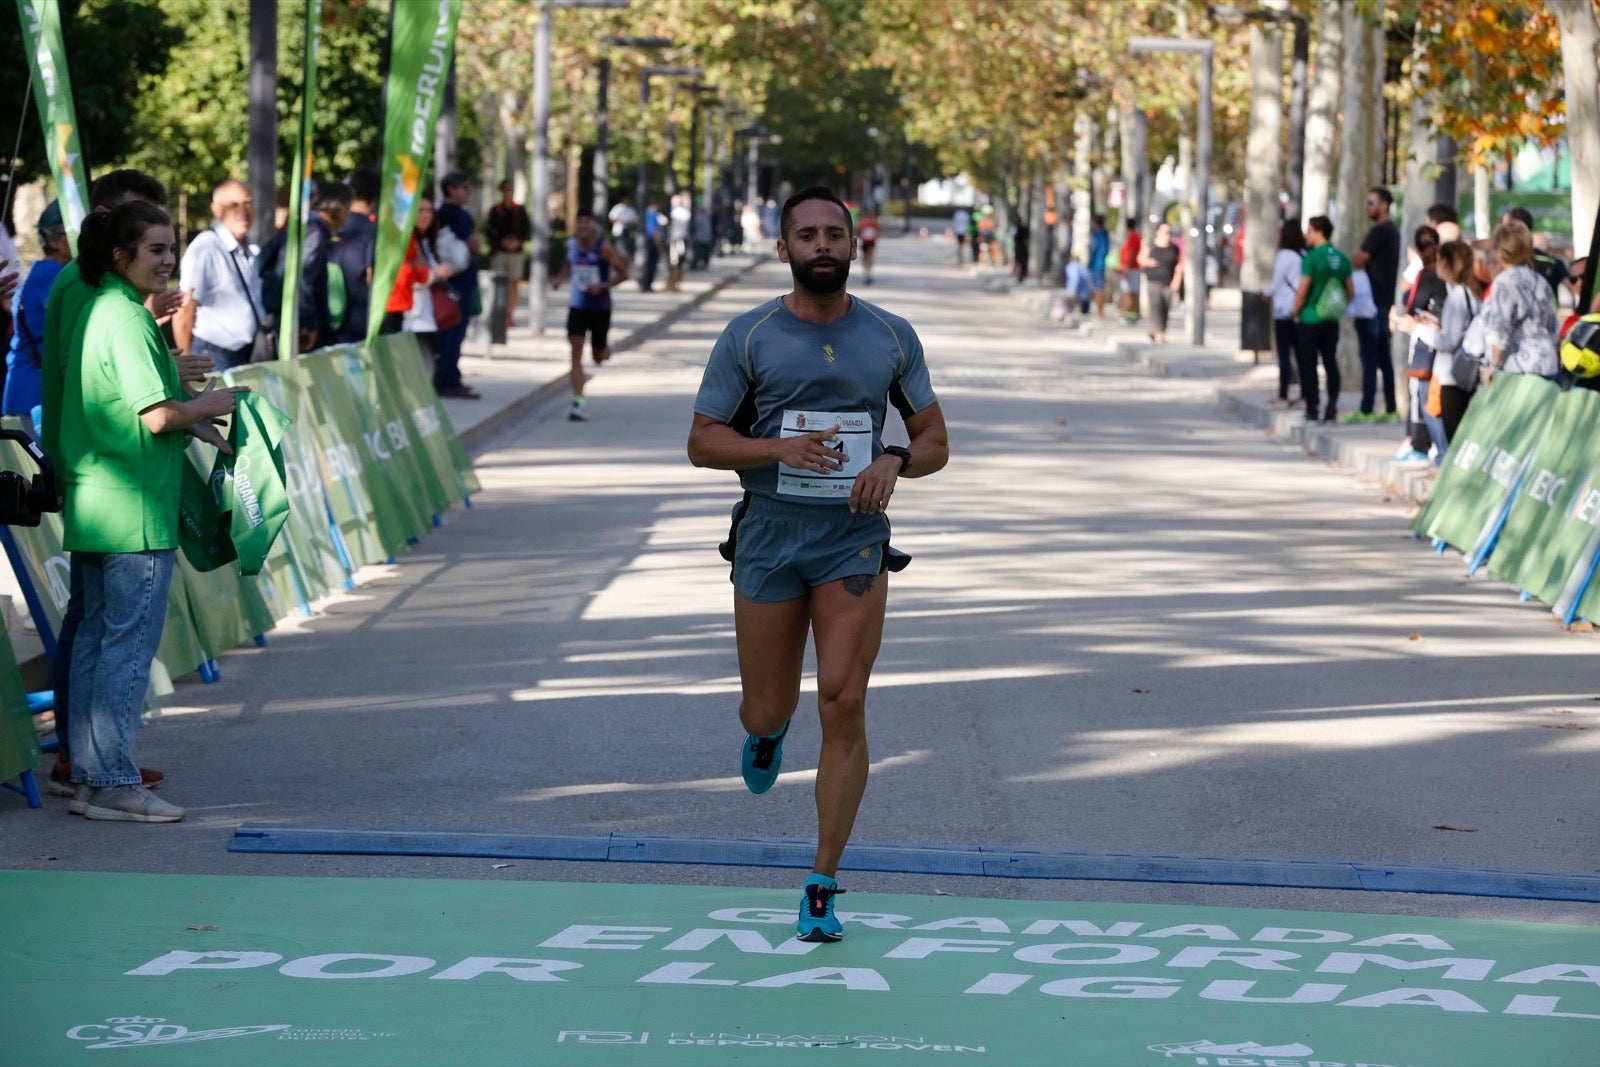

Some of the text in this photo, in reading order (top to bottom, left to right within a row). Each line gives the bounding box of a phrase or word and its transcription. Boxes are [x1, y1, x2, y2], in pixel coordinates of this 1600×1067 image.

[235, 474, 264, 528] GRANADA
[707, 907, 1454, 951] GRANADA
[122, 949, 585, 983] POR
[634, 962, 891, 991] LA
[536, 924, 1600, 989] EN FORMA
[66, 1024, 188, 1042] CSD
[667, 1039, 986, 1053] DEPORTE JOVEN
